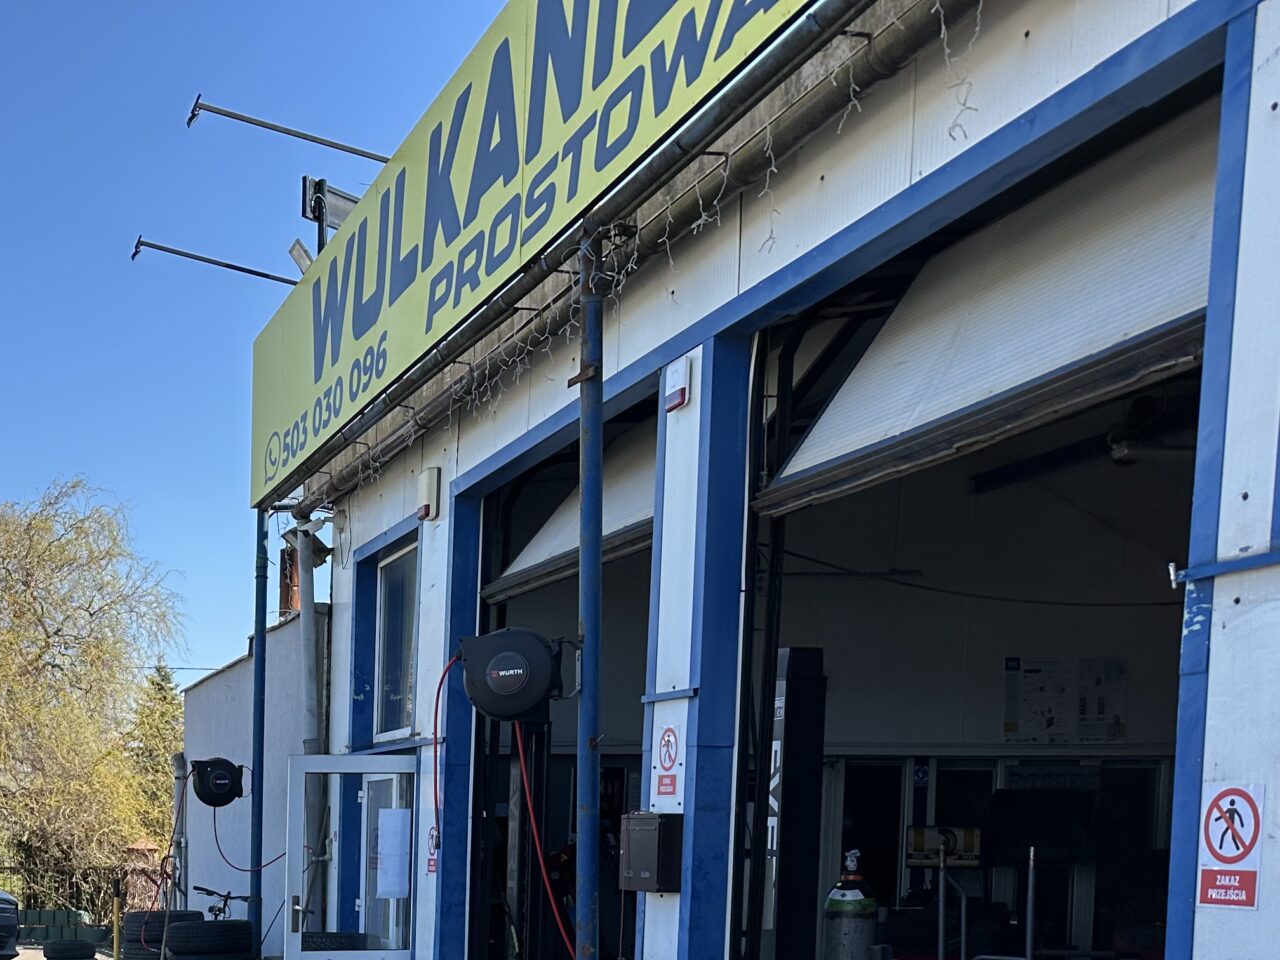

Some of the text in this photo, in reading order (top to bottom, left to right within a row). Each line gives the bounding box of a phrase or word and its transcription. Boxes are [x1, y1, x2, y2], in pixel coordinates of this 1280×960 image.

[282, 330, 388, 467] 503 030 096
[1216, 874, 1240, 886] ZAKAZ
[1207, 887, 1246, 901] PRZEJŚCIA
